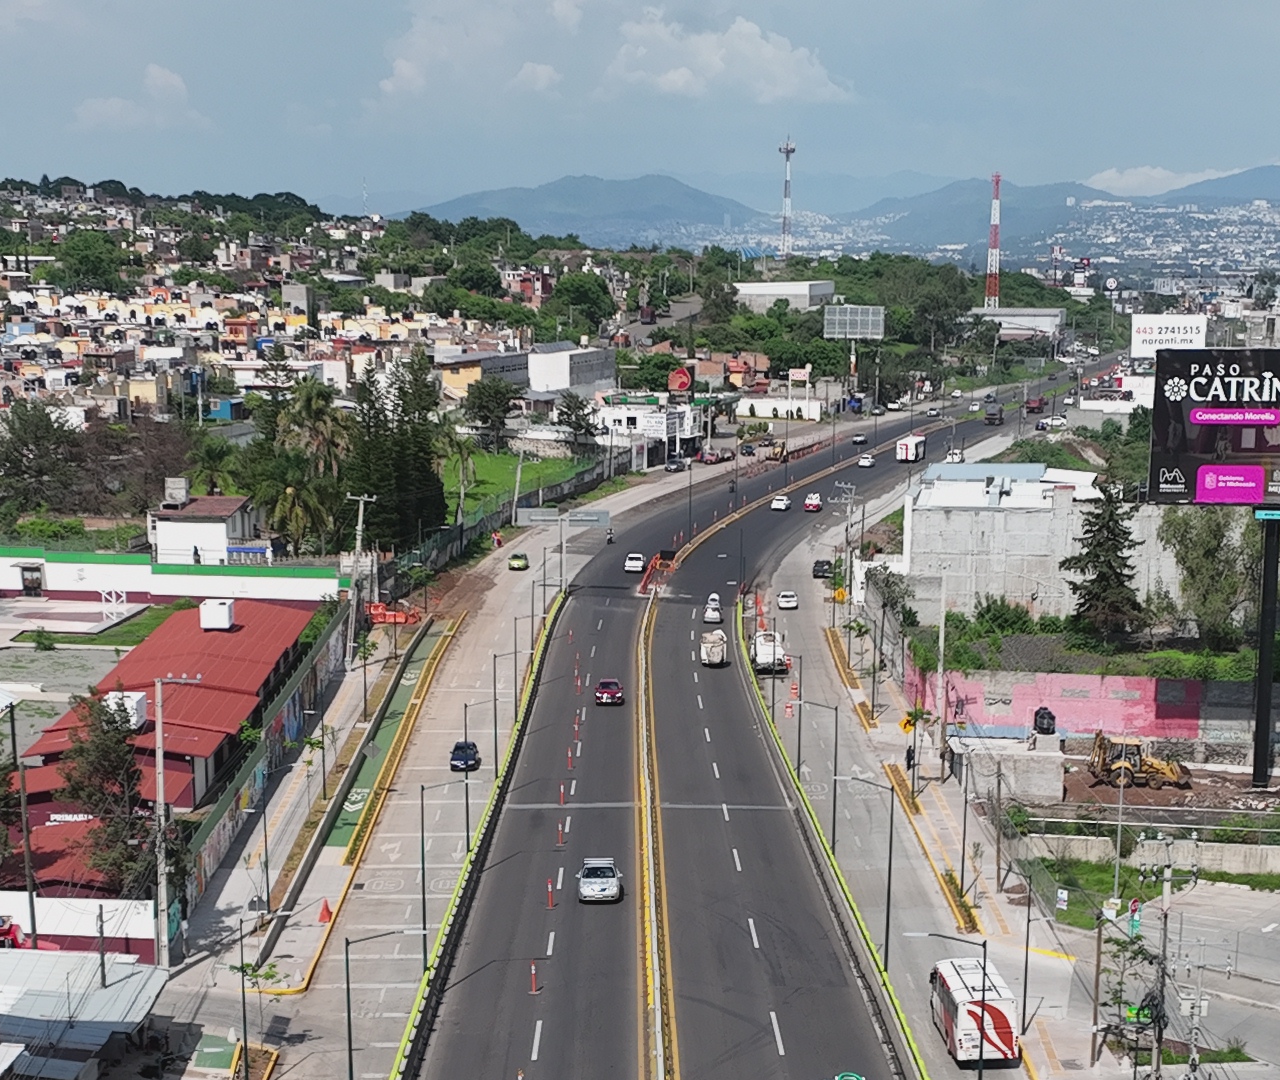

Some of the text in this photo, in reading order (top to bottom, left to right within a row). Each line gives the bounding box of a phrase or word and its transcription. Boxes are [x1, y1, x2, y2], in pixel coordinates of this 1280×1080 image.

[1135, 326, 1201, 335] 443 2741515
[1190, 363, 1240, 376] PASO
[1195, 411, 1276, 421] Conectando Morelia
